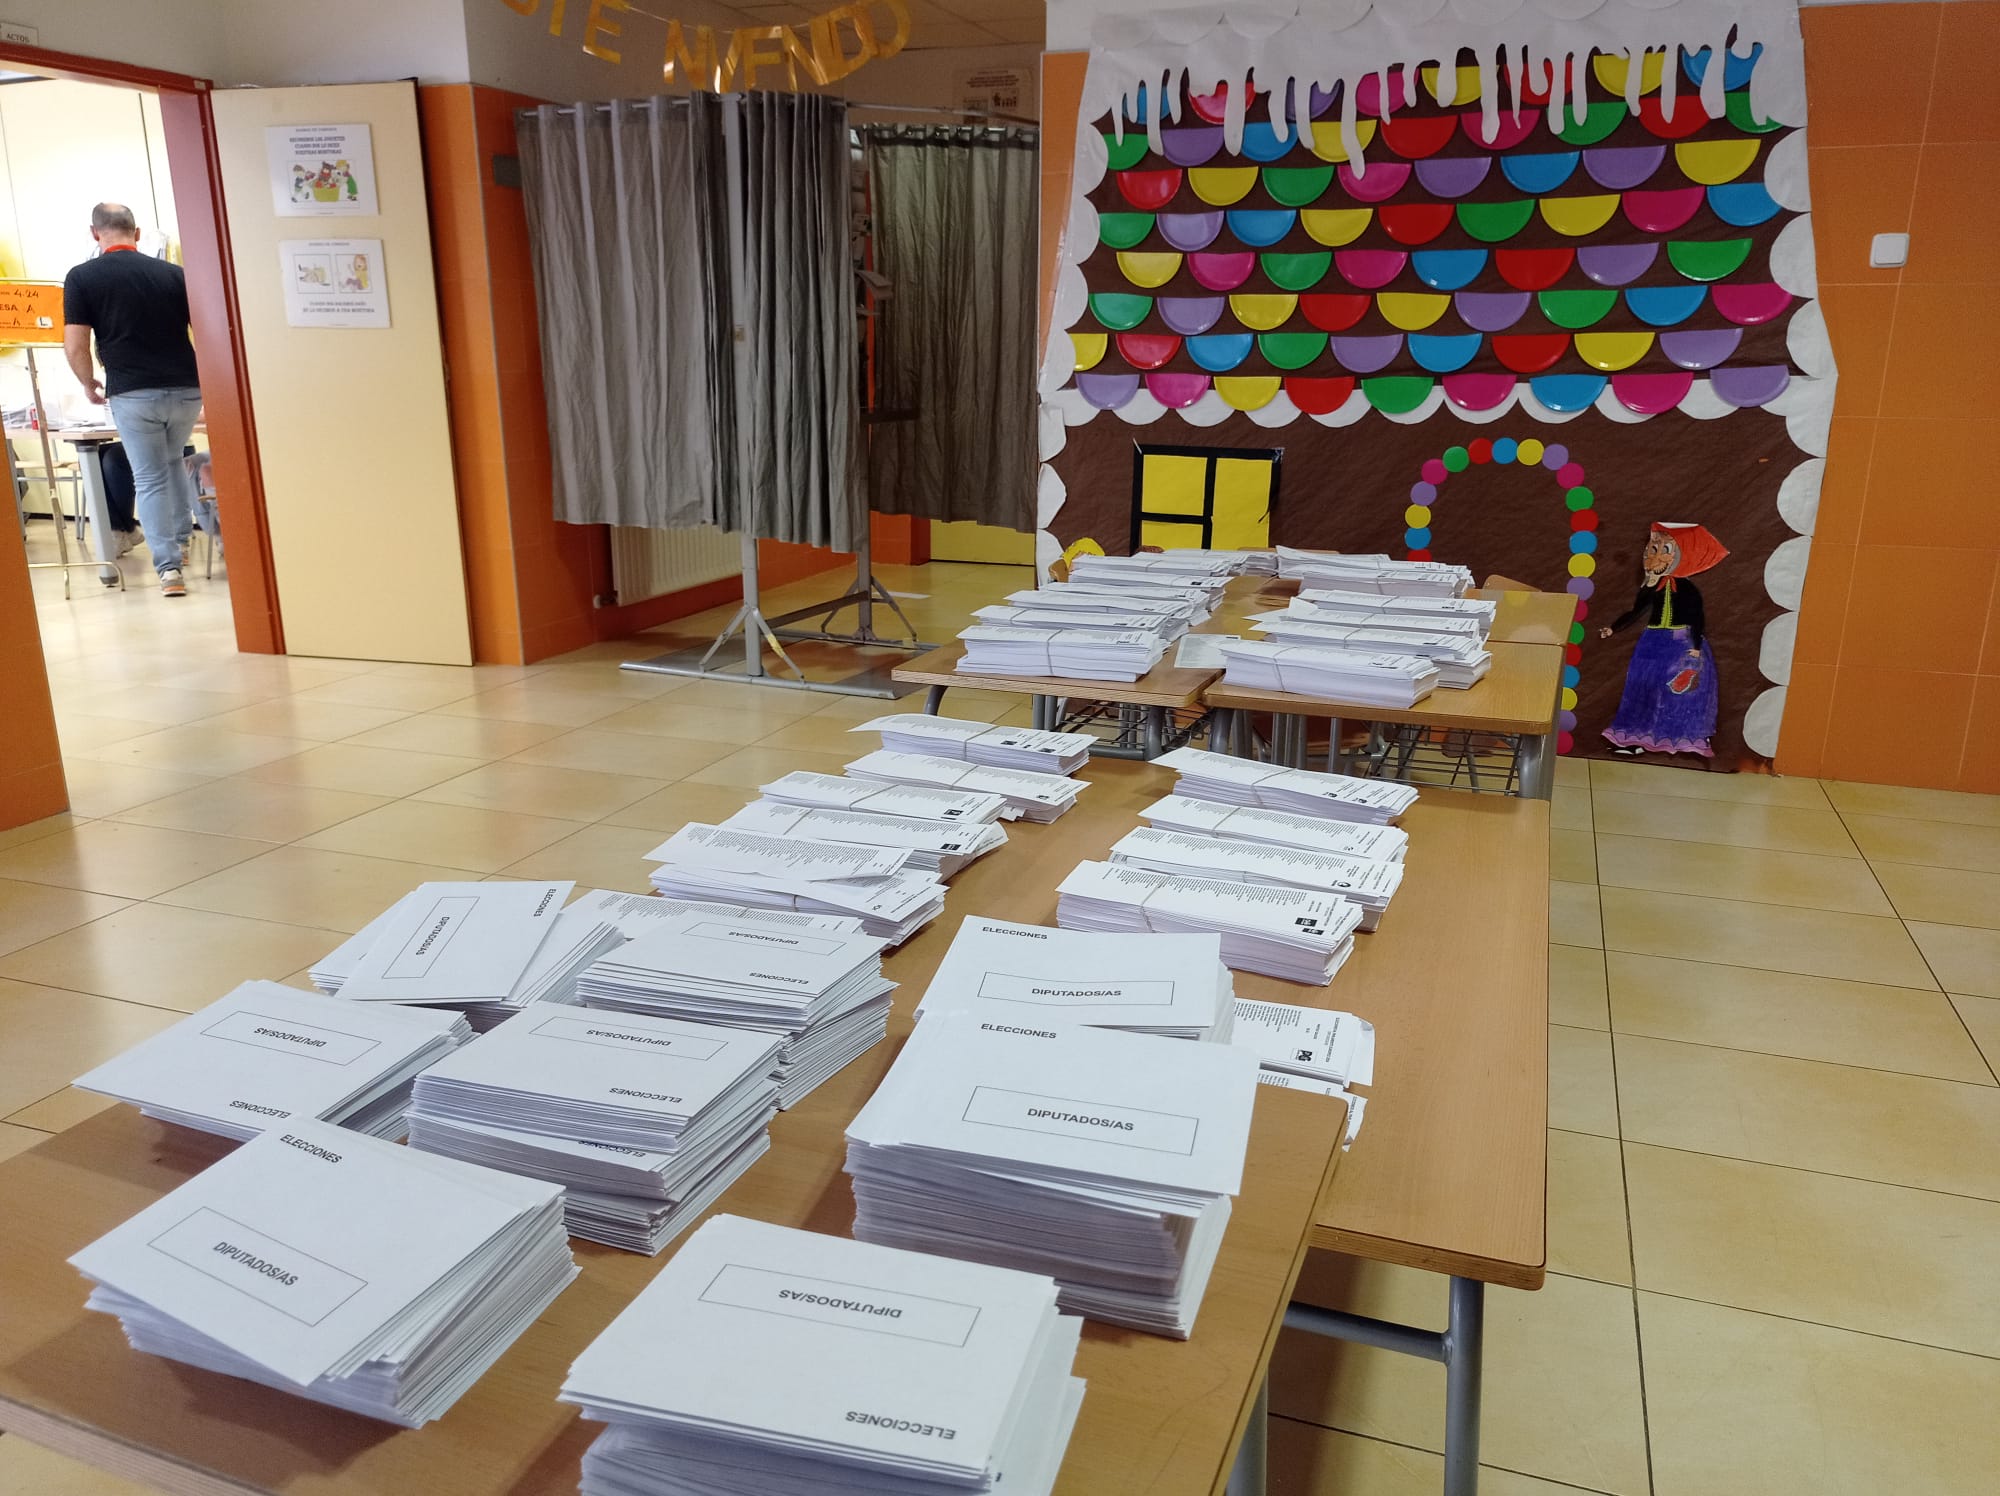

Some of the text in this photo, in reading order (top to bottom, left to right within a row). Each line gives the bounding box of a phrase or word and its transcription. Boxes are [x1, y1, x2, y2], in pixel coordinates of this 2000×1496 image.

[26, 303, 36, 314] A
[533, 888, 557, 918] ELECCIONES
[415, 916, 450, 956] DIPUTADOS/AS
[728, 931, 799, 945] DIPUTADOS/AS
[982, 926, 1048, 940] ELECCIONES
[748, 972, 809, 985] ELECCIONES
[1031, 988, 1122, 997] DIPUTADOS/AS
[254, 1027, 327, 1047] DIPUTADOS/AS
[586, 1029, 672, 1046] DIPUTADOS/AS
[980, 1023, 1057, 1039] ELECCIONES
[608, 1087, 683, 1104] ELECCIONES
[229, 1100, 292, 1119] ELECCIONES
[1027, 1108, 1134, 1131] DIPUTADOS/AS
[279, 1134, 342, 1163] ELECCIONES
[213, 1241, 299, 1286] DIPUTADOS/AS
[778, 1289, 903, 1318] DIPUTADOS/AS
[845, 1411, 956, 1440] ELECCIONES
